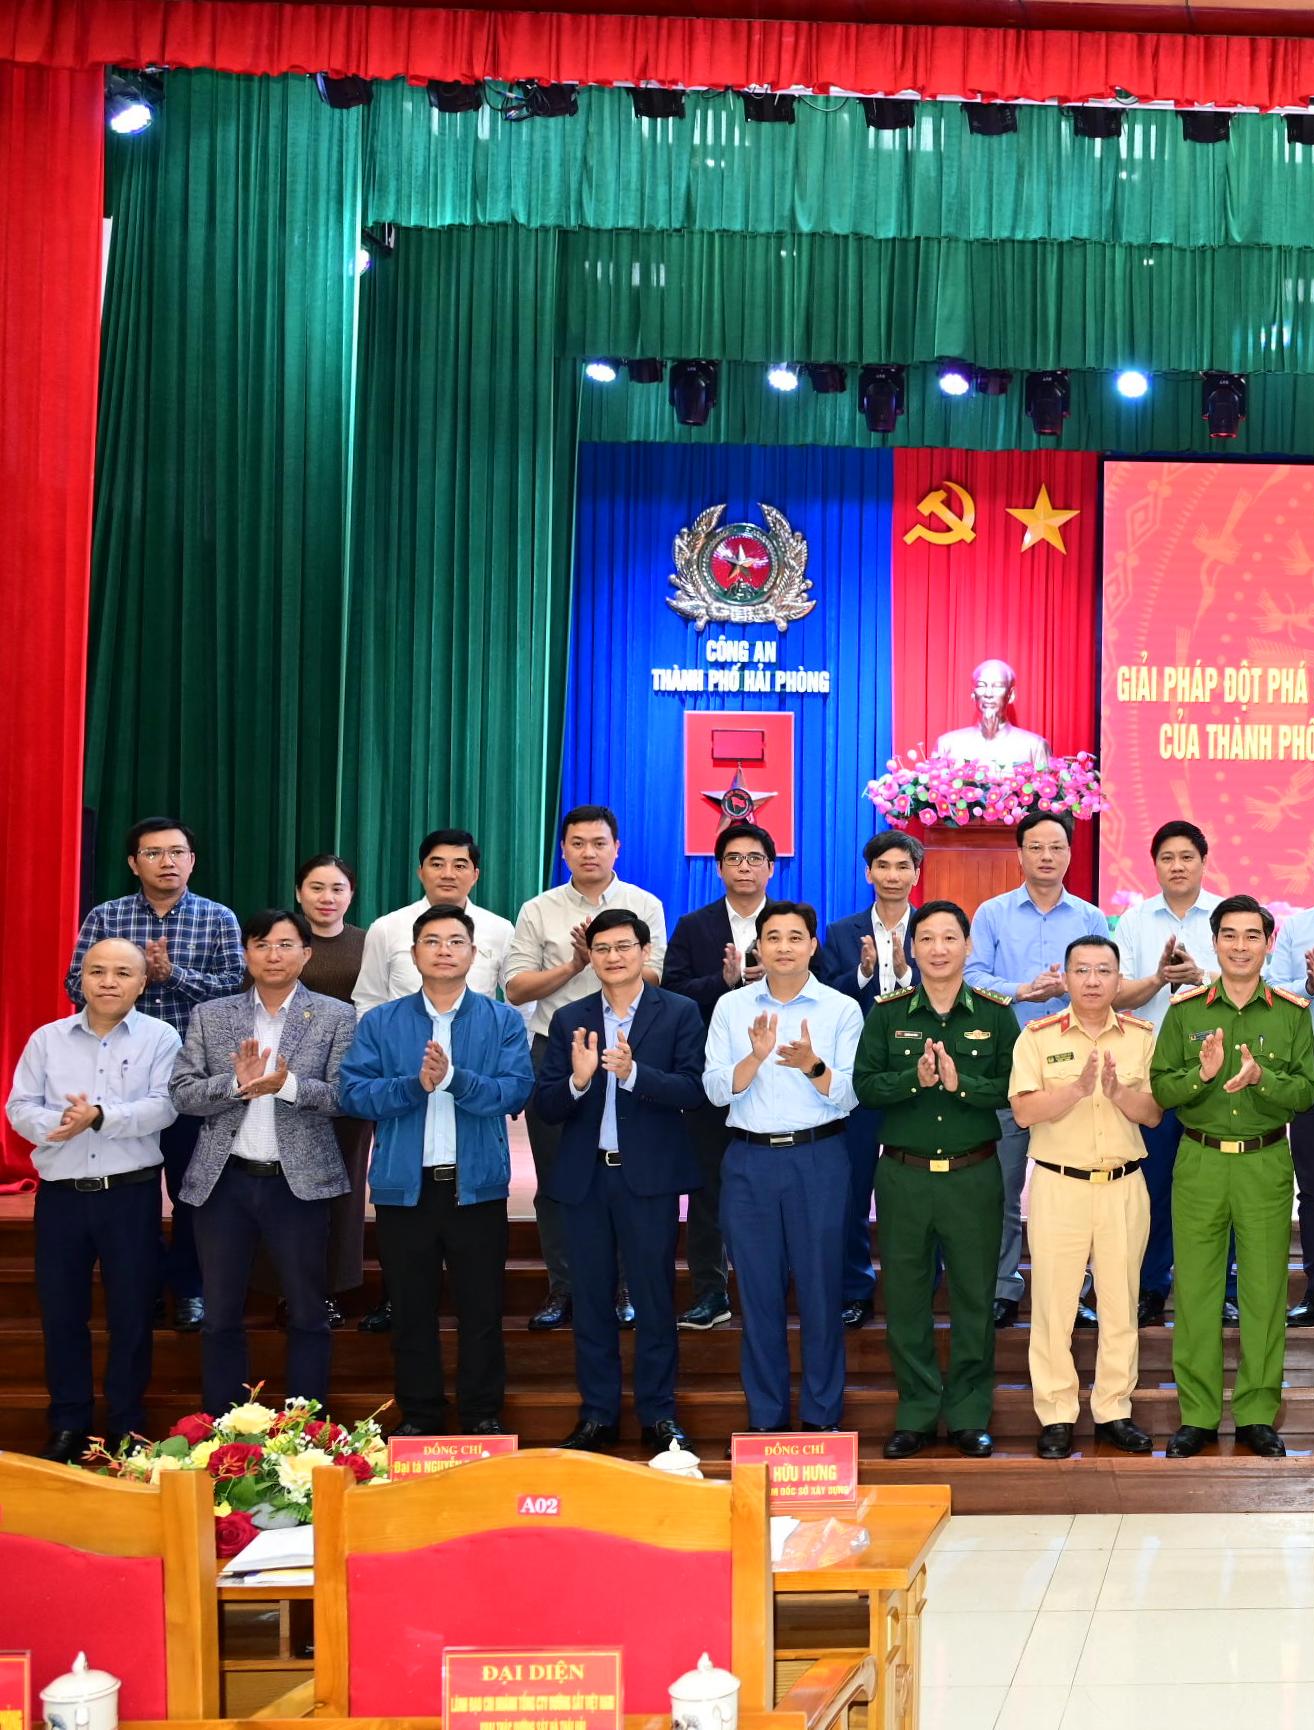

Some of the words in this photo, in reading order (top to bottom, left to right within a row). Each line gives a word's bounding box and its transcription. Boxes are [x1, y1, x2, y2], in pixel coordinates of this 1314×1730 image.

[706, 635, 749, 662] CÔNG
[753, 641, 777, 662] AN
[651, 664, 704, 692] THÀNH
[708, 663, 741, 692] PHỐ
[744, 663, 771, 692] HẢI
[775, 666, 830, 693] PHÒNG
[1116, 651, 1157, 702] GIẢI
[1163, 659, 1217, 703] PHÁP
[1223, 659, 1262, 712] ĐỘT
[1267, 660, 1308, 704] PHÁ
[1159, 708, 1200, 760] CỦA
[1206, 717, 1272, 761] THÀNH
[802, 1442, 825, 1455] CHÍ
[773, 1463, 799, 1482] HỮU
[802, 1464, 838, 1481] HƯNG
[520, 1497, 559, 1514] A02
[482, 1664, 522, 1685] ĐẠI
[529, 1660, 585, 1684] DIỆN
